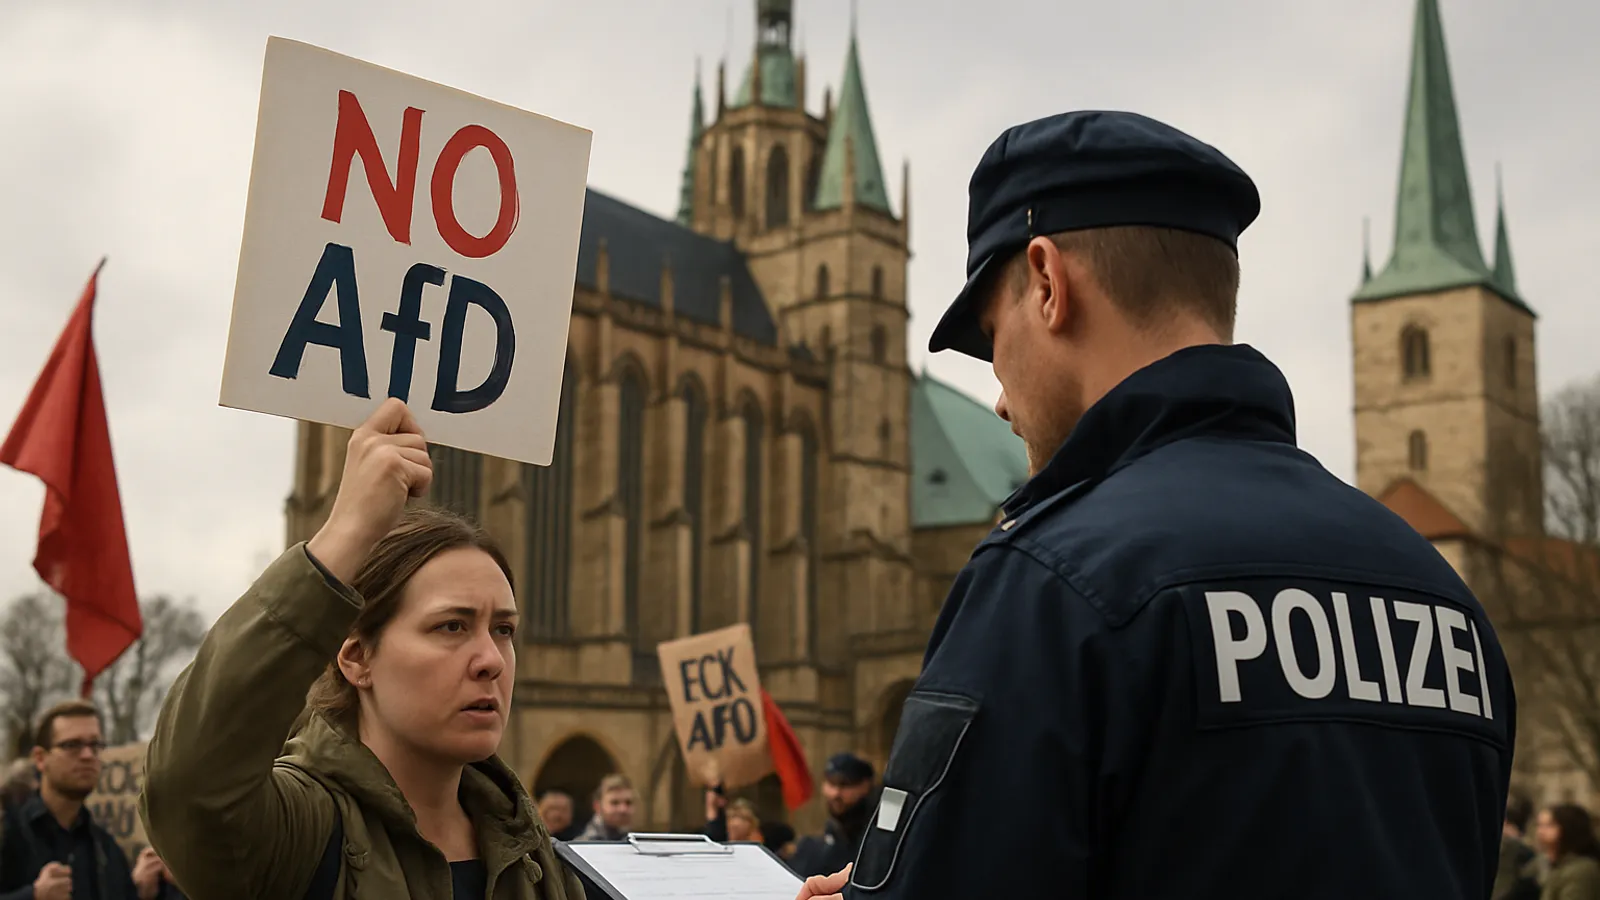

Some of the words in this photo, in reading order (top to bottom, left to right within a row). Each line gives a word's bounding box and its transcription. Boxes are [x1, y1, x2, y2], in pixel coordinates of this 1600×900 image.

[321, 89, 519, 258] NO
[269, 242, 516, 413] AfD
[1204, 588, 1493, 720] POLIZEI
